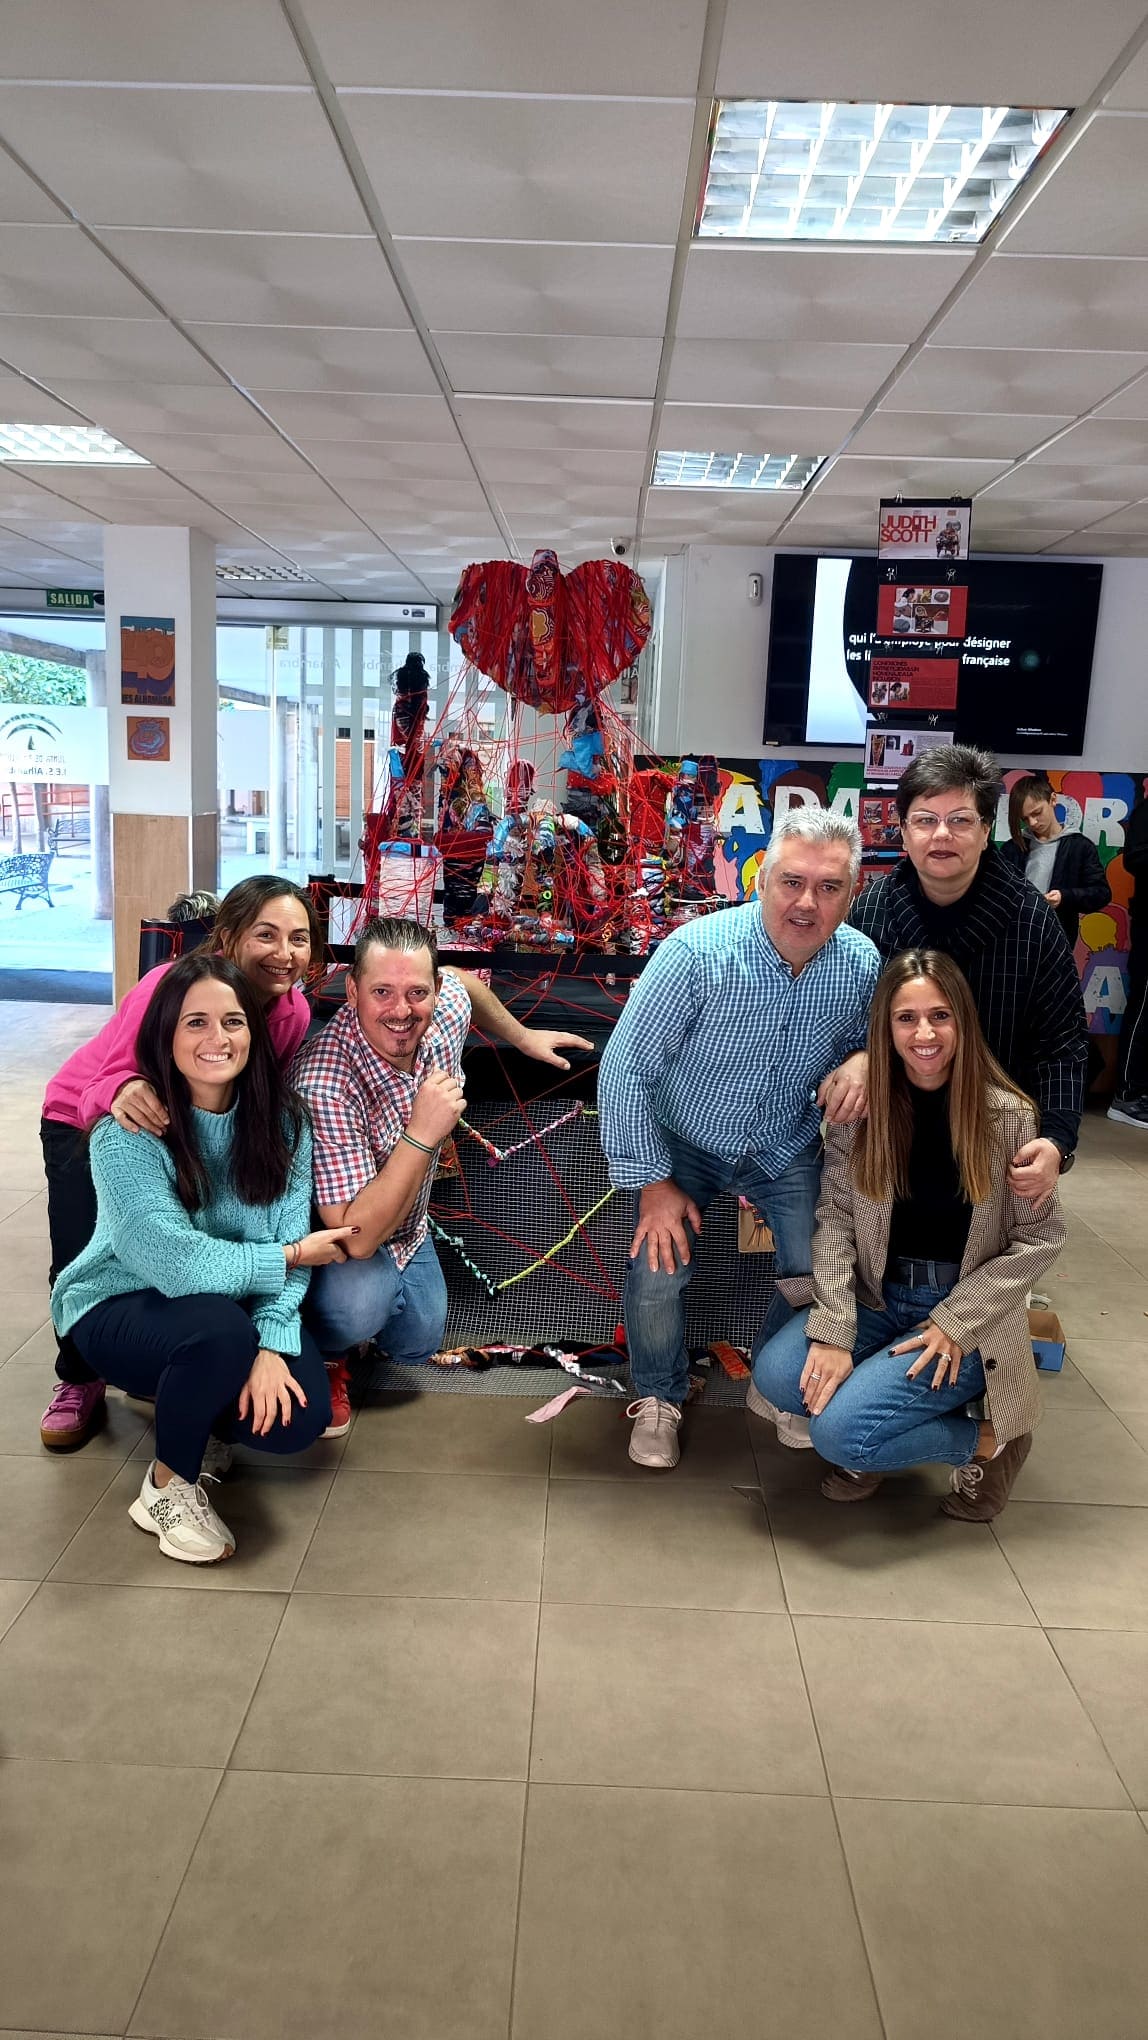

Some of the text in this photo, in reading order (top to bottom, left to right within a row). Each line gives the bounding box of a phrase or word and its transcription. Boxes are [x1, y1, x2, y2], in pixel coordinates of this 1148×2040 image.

[881, 515, 937, 529] JUDITH
[881, 529, 933, 543] SCOTT
[50, 593, 90, 605] SALIDA
[849, 633, 867, 647] qui
[963, 636, 1012, 651] désigner
[846, 649, 862, 661] les
[962, 654, 1011, 668] française
